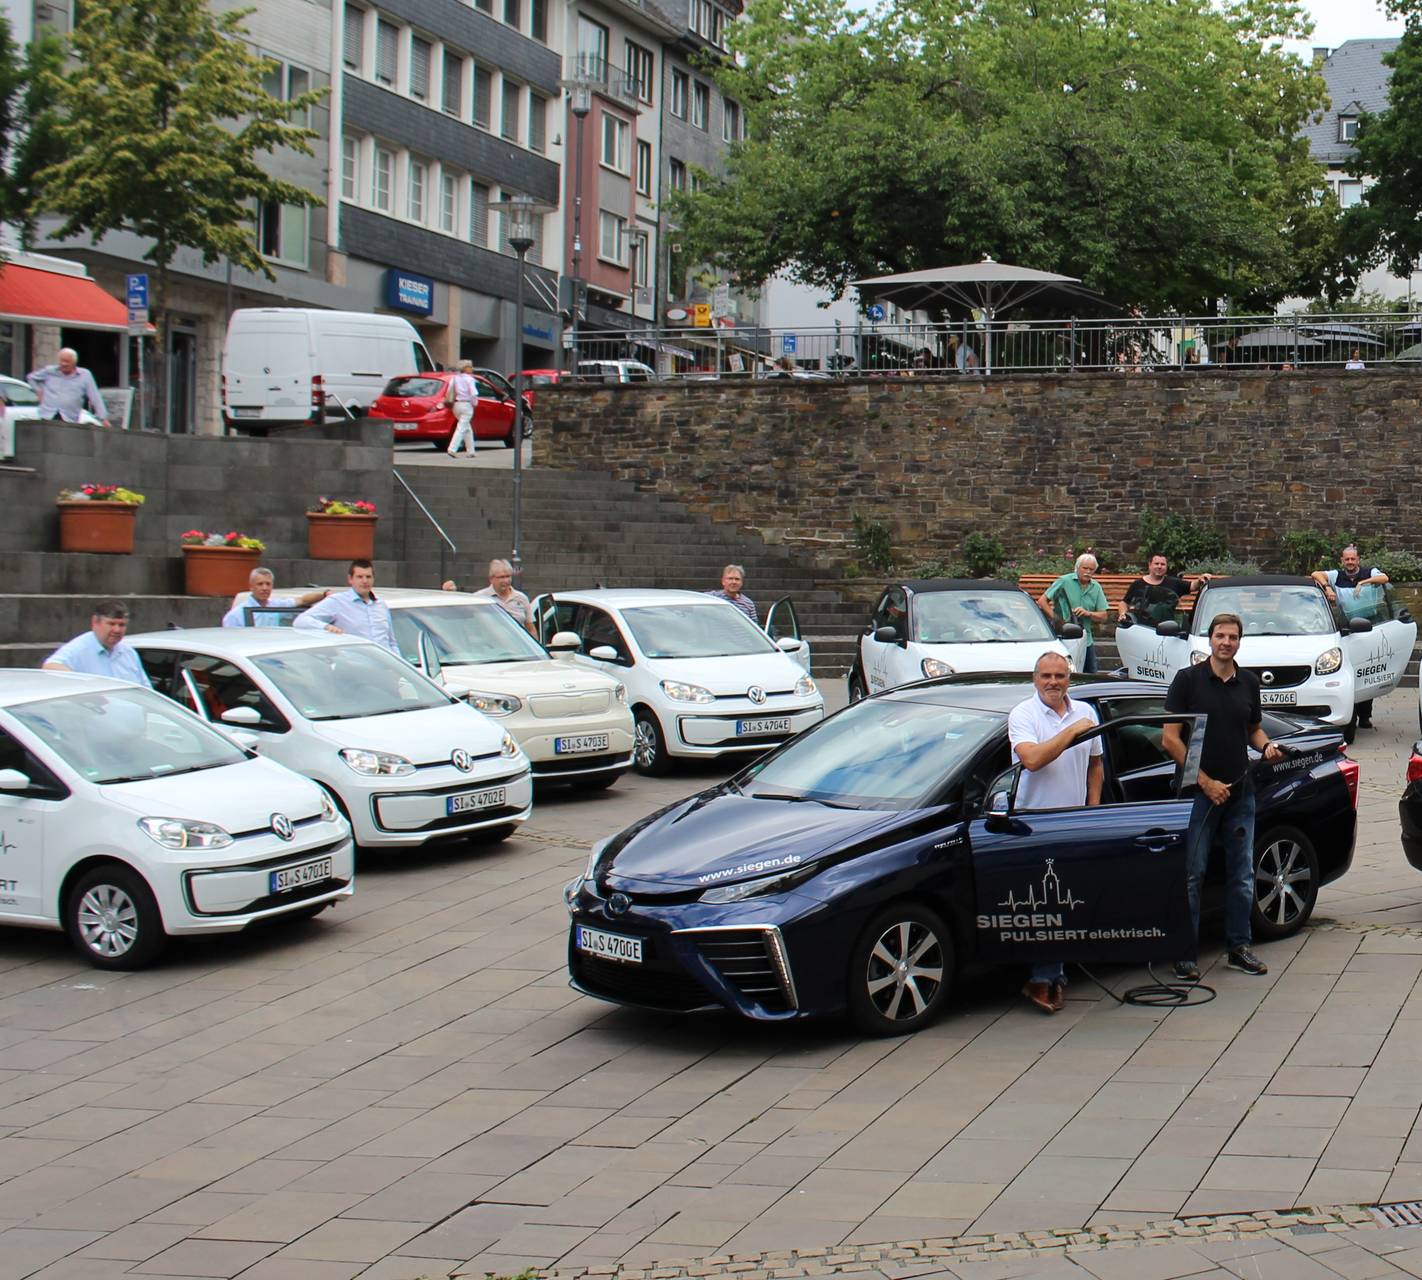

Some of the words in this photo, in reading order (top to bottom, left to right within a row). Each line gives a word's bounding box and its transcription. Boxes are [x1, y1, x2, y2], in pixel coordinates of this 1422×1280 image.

[399, 277, 429, 294] KIESER
[399, 292, 429, 309] TRAINING
[1137, 665, 1165, 680] SIEGEN
[1356, 663, 1387, 678] SIEGEN
[1364, 672, 1395, 685] PULSIERT
[1269, 693, 1295, 703] 4706E
[764, 720, 788, 731] 4704E
[583, 736, 608, 748] 4703E
[1273, 752, 1323, 773] www.siegen.de
[478, 790, 504, 806] 4702E
[302, 861, 330, 881] 4701E
[699, 854, 801, 883] www.siegen.de
[976, 913, 1063, 929] SIEGEN
[1000, 929, 1088, 942] PULSIERT
[1089, 927, 1166, 940] elektrisch.
[607, 936, 640, 959] 4700E
